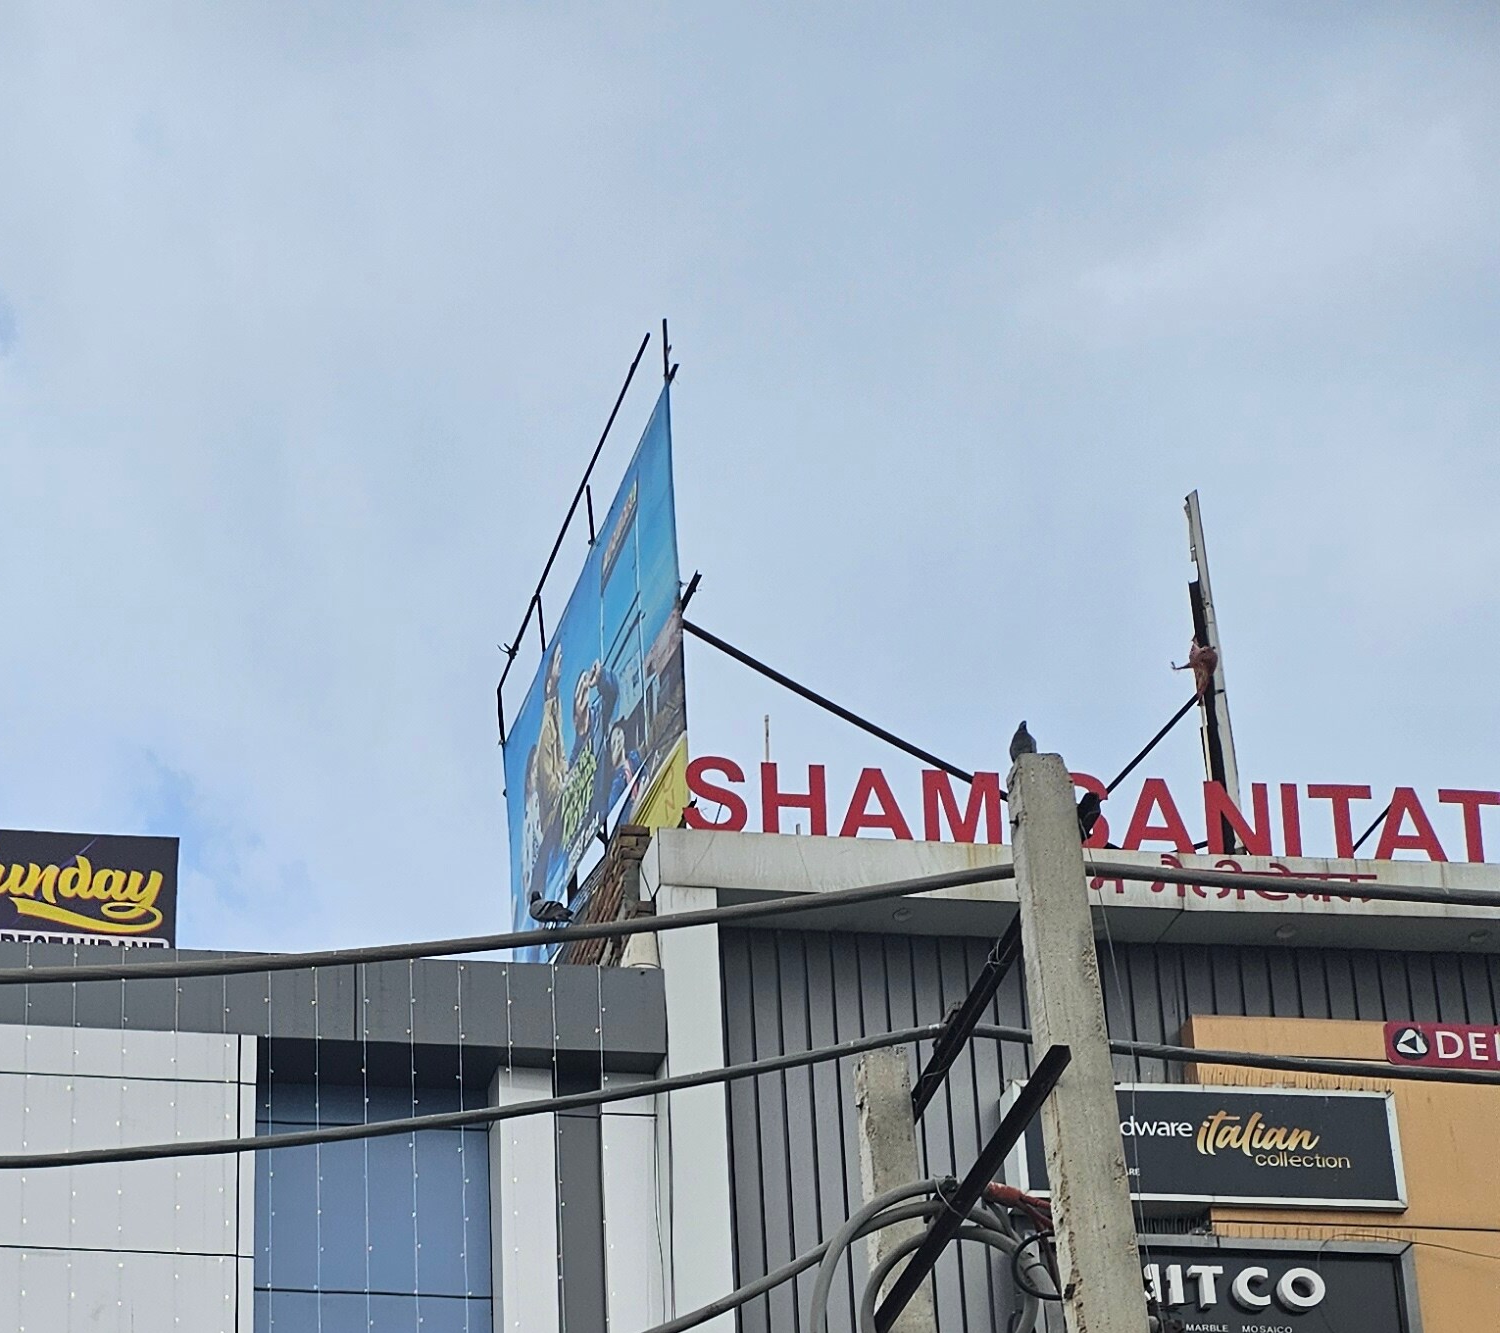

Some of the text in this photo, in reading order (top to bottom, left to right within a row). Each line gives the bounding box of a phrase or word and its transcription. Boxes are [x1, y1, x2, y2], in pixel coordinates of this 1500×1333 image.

[683, 755, 1003, 845] SHAM
[1435, 1030, 1500, 1062] DE
[1119, 1110, 1321, 1156] dware italian
[1254, 1151, 1351, 1169] collection
[1185, 1323, 1229, 1333] MARBLE
